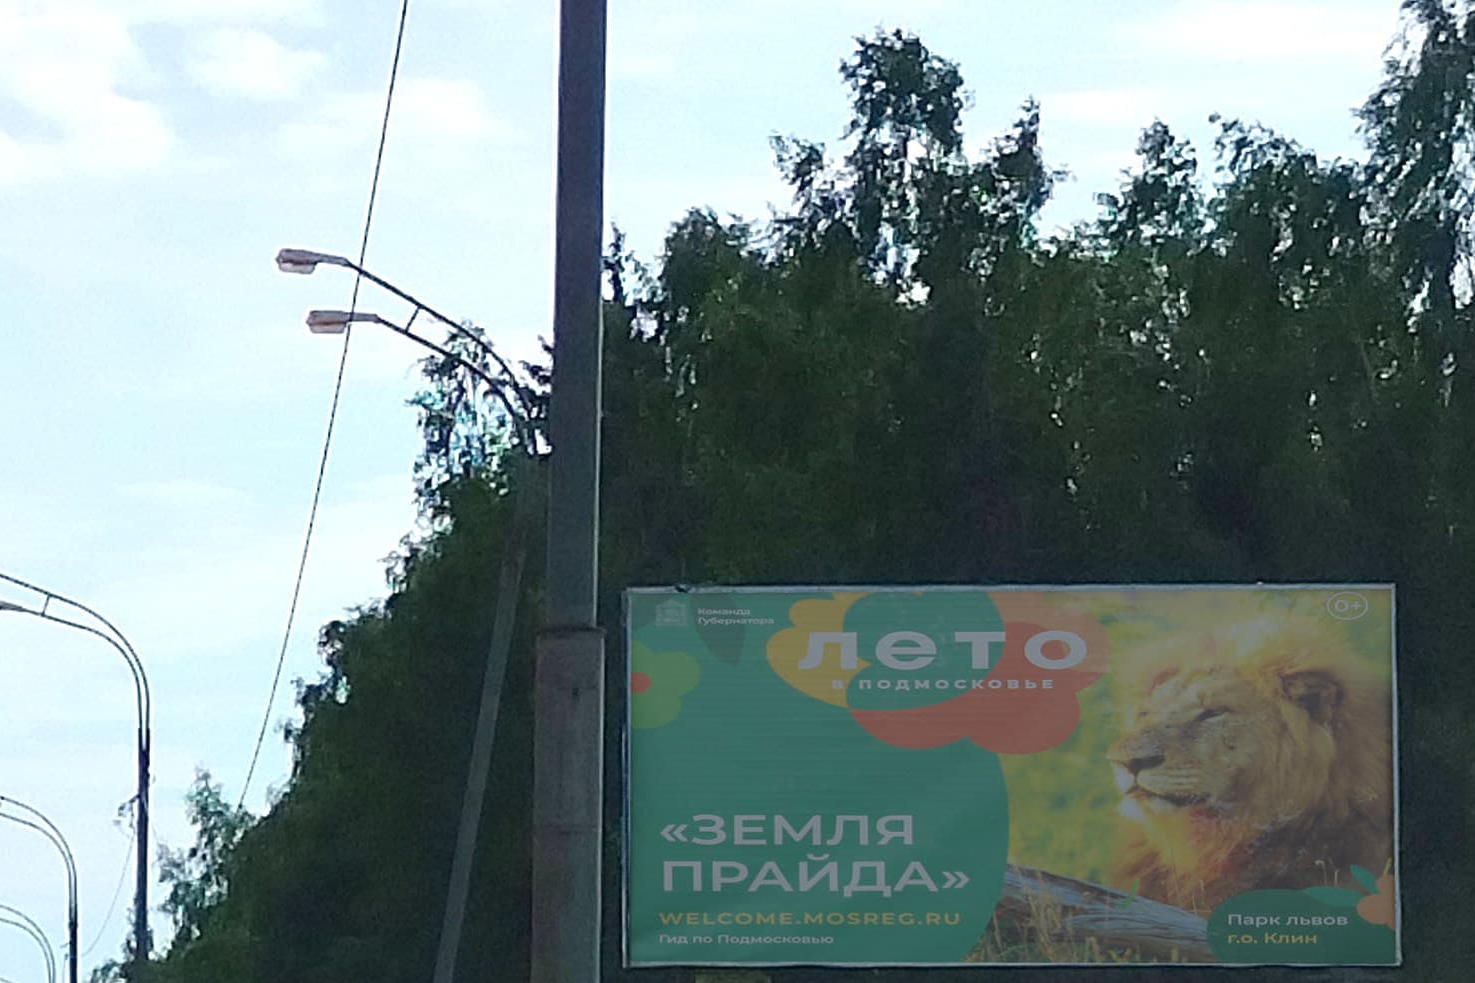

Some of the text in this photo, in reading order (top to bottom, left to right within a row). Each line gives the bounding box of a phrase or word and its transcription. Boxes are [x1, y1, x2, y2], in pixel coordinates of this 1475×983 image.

[697, 607, 750, 615] Команда
[697, 616, 775, 626] Губернатора
[858, 679, 1054, 691] ПОДМОСКОВЬЕ
[659, 814, 913, 846] «ЗЕМЛЯ
[662, 853, 970, 898] ПРАЙДА»
[658, 912, 961, 926] WELCOME.MOSREG.RU
[1228, 913, 1349, 928] Парк львов
[658, 934, 834, 945] Гид по Подмосковью
[1264, 932, 1318, 944] Клин
